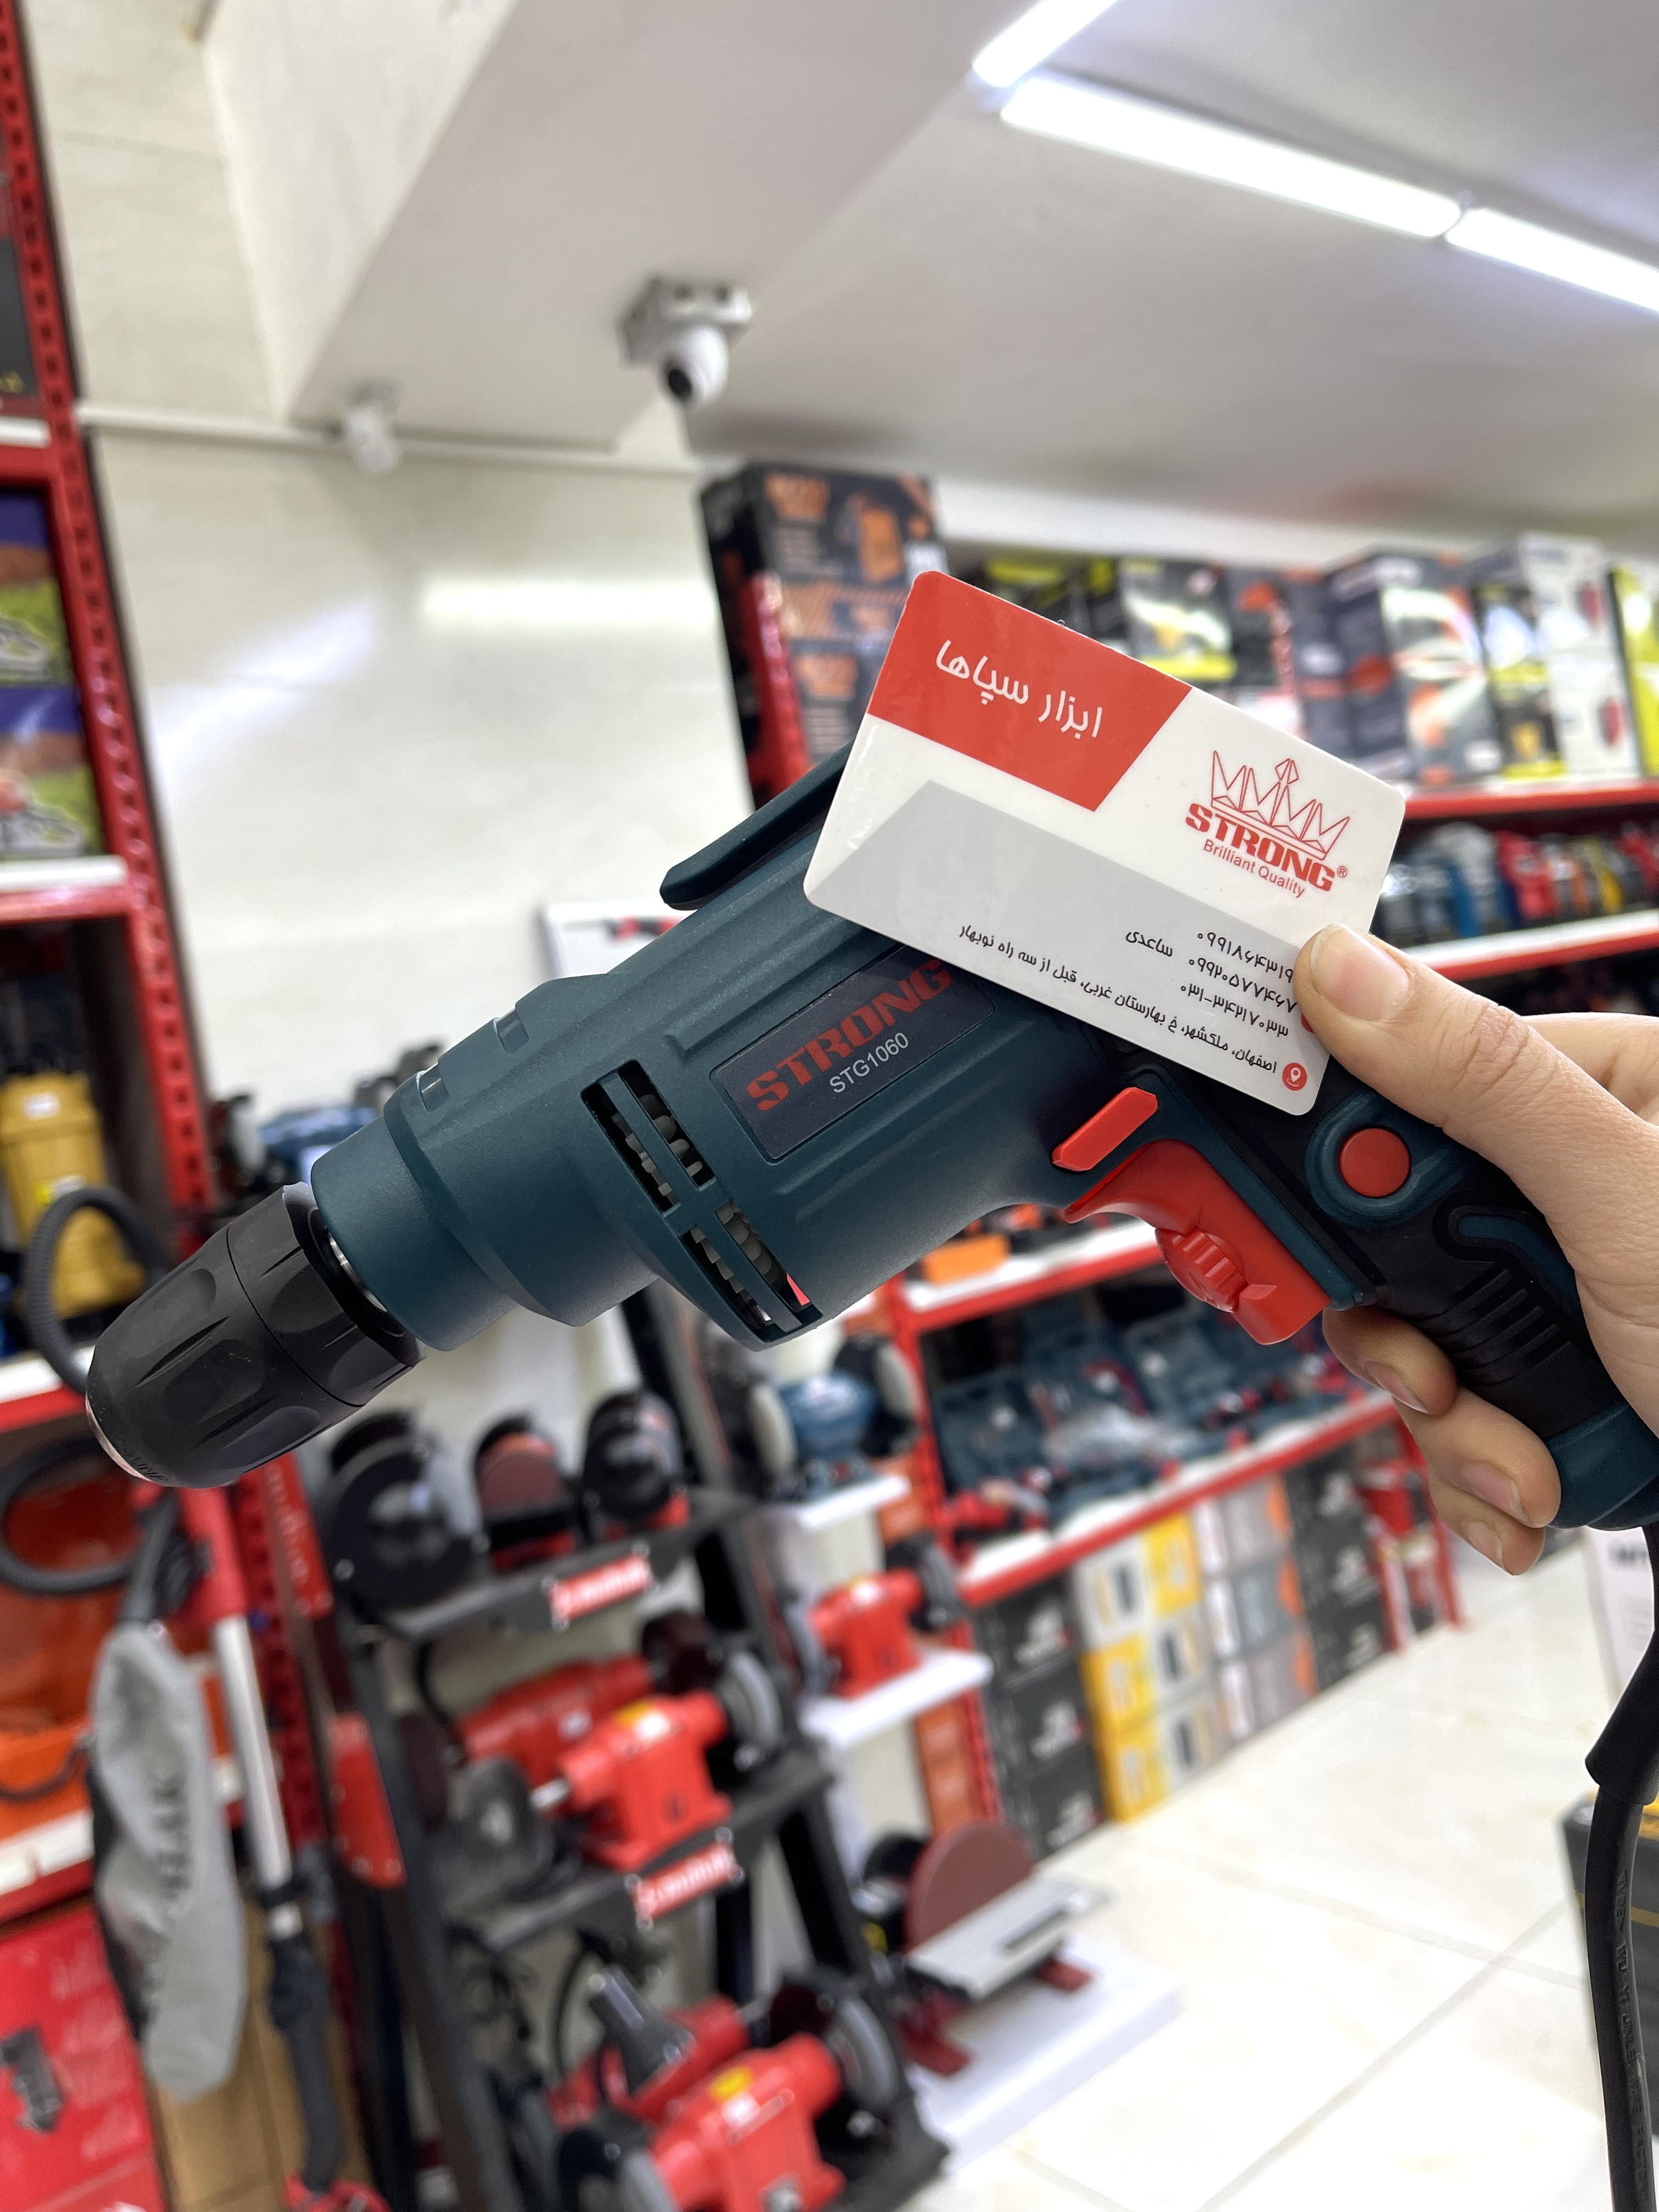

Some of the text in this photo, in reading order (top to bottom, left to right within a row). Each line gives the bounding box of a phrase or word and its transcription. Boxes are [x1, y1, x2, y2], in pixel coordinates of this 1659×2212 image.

[935, 639, 1103, 740] ابزار سپاها
[1203, 838, 1305, 898] Brilliant Quality
[959, 924, 995, 947] نوبهار
[998, 941, 1014, 958] راه
[1018, 951, 1037, 966] سه
[1039, 958, 1051, 973] از
[1052, 965, 1077, 983] قبل
[1125, 931, 1297, 1014] ۰۹۹۲۰۵۷۷۴۶۷ ساعدی
[1197, 932, 1294, 983] ۰۹۹۱۸۶۴۳۱۹
[1114, 994, 1165, 1025] بهارستان
[747, 958, 952, 1111] STRONG
[829, 1032, 910, 1093] STG1060
